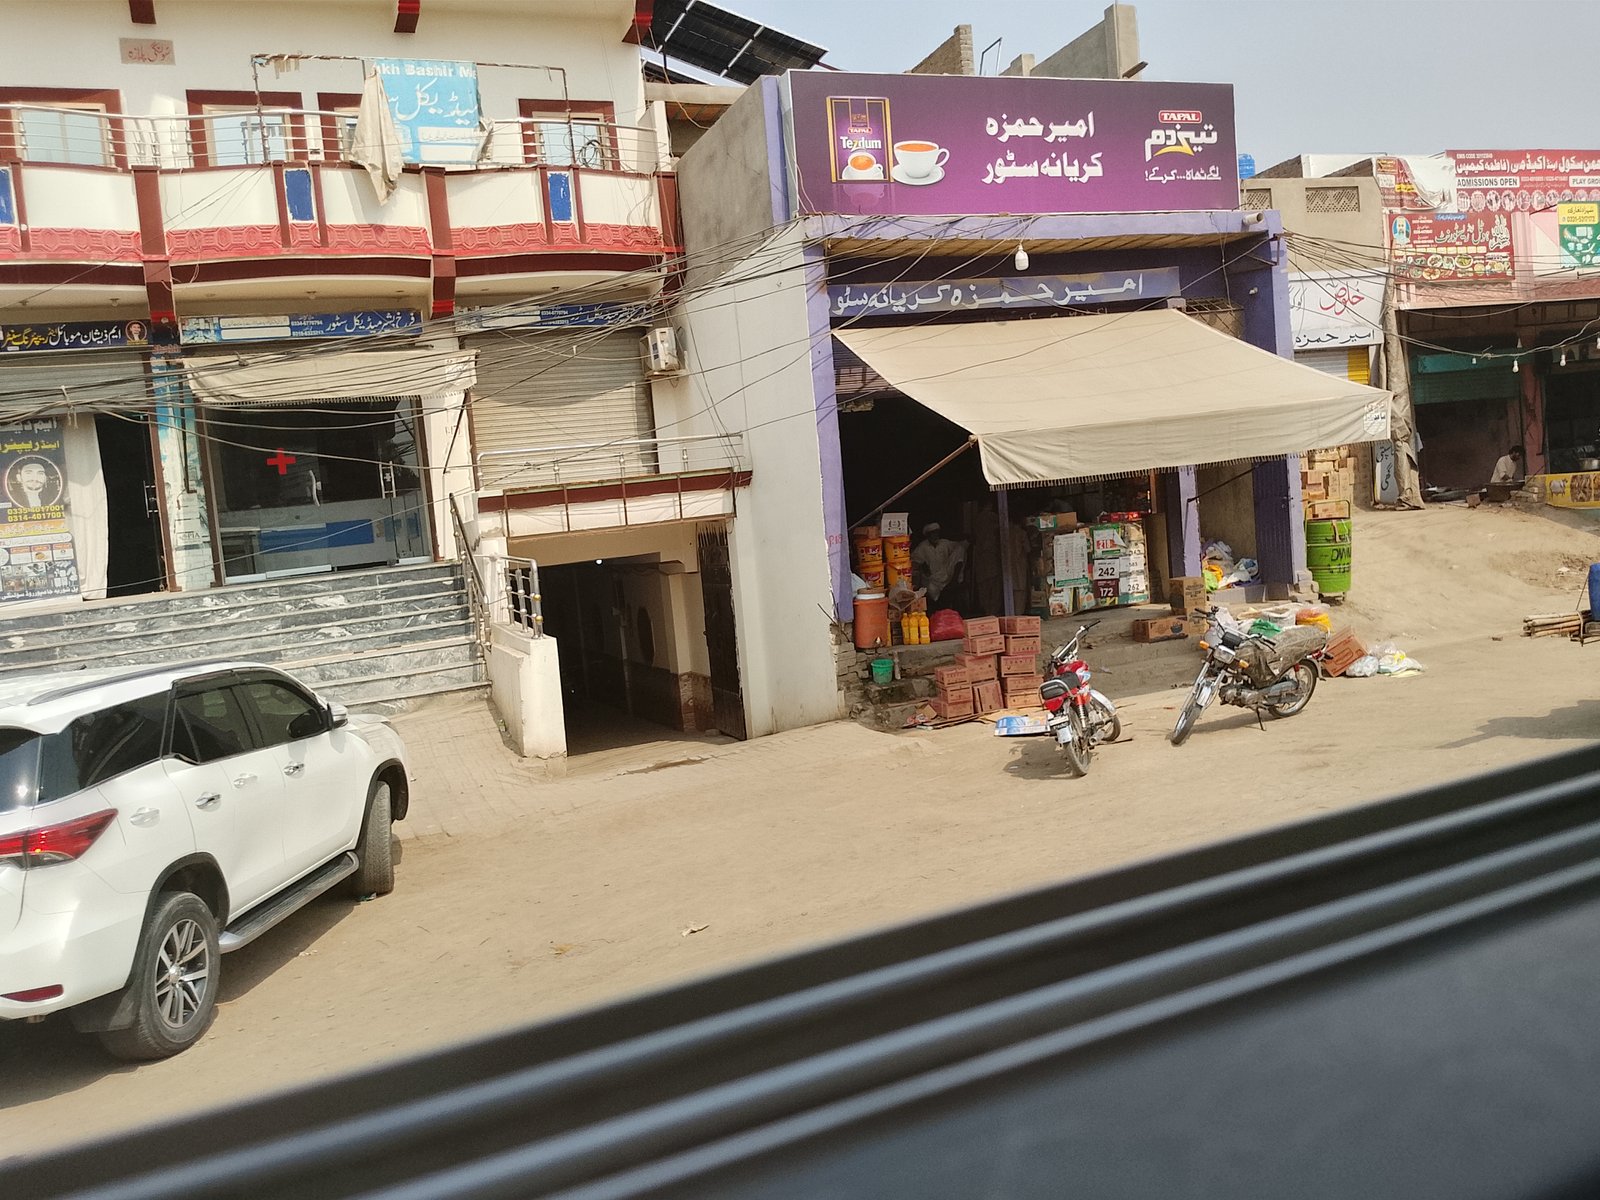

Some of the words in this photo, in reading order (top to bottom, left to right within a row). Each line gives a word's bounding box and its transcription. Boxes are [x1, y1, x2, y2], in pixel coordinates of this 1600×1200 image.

[405, 64, 453, 77] Bashir
[1161, 112, 1200, 121] TAPAL
[985, 113, 1044, 143] حمزہ
[1044, 111, 1095, 143] امیر
[840, 136, 882, 152] Tezdum
[981, 149, 1039, 184] سٹور
[1040, 152, 1104, 184] کریانہ
[1457, 178, 1497, 187] ADMISSIONS
[1500, 177, 1518, 186] OPEN
[951, 283, 1055, 309] حمزہ
[1055, 272, 1144, 306] امیر
[868, 284, 951, 312] کریانہ
[325, 315, 347, 331] سٹور
[344, 312, 383, 333] میڈیکل
[49, 324, 80, 346] موبائل
[80, 328, 108, 344] ذیشان
[108, 325, 121, 345] ایم
[1295, 333, 1339, 347] حمزہ
[1339, 329, 1375, 344] امیر
[7, 511, 65, 522] 0314-4017001
[1098, 567, 1115, 577] 242
[1100, 588, 1114, 597] 172
[1127, 584, 1140, 592] 262
